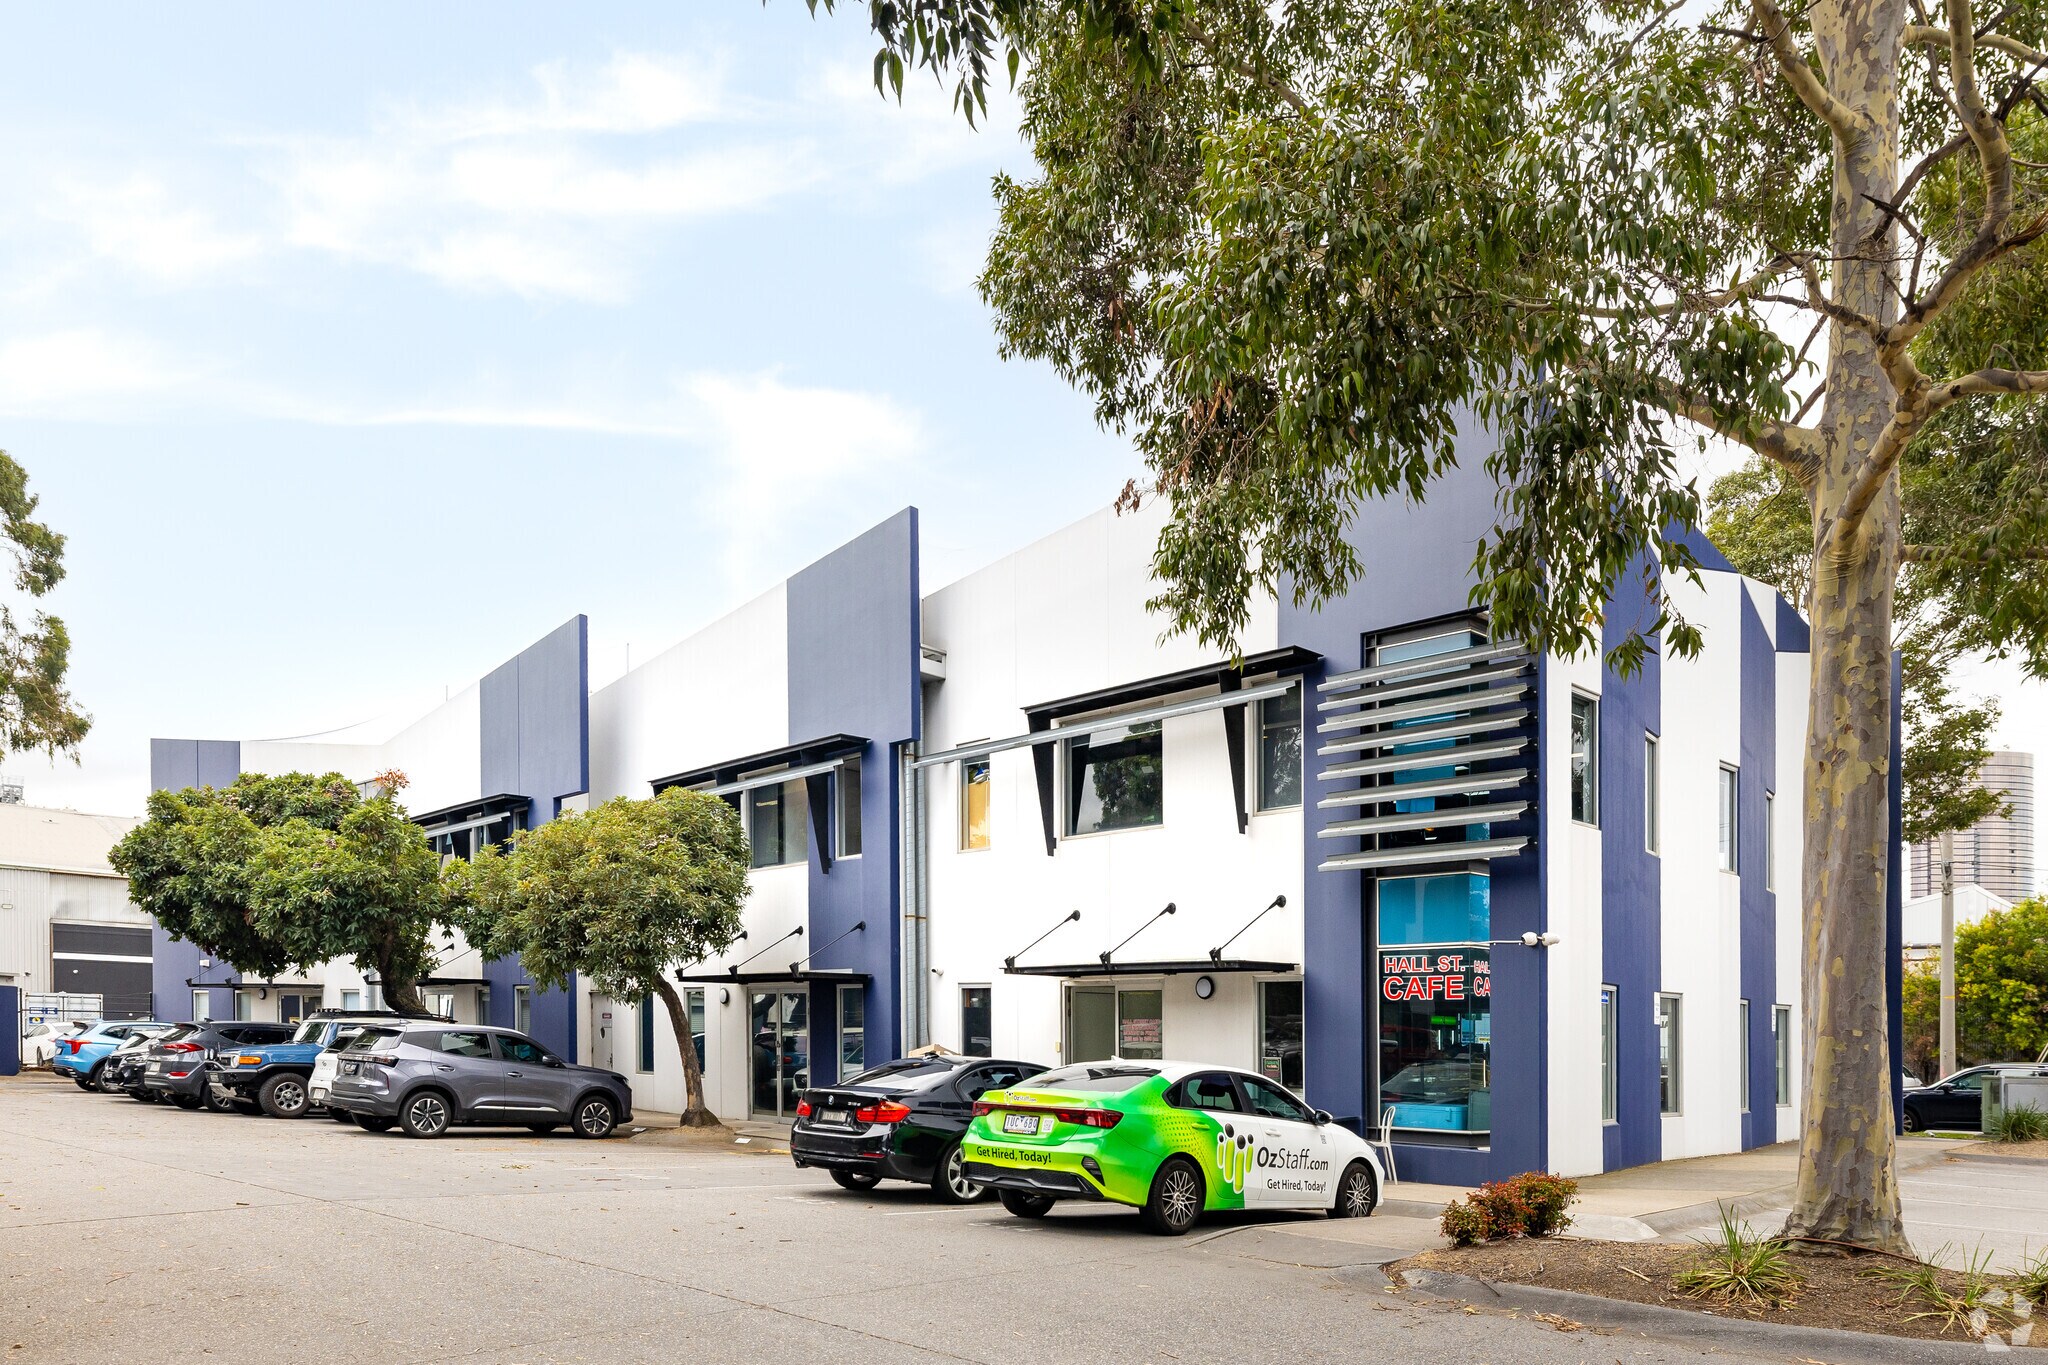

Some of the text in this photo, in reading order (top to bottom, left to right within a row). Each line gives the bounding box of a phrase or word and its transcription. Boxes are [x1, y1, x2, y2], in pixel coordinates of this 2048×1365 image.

[1384, 955, 1466, 974] HALL ST.
[1383, 975, 1465, 1001] CAFE
[976, 1146, 1052, 1165] Get Hired, Today!
[1257, 1146, 1329, 1171] OzStaff.com
[1267, 1178, 1326, 1194] Get Hired, Today!
